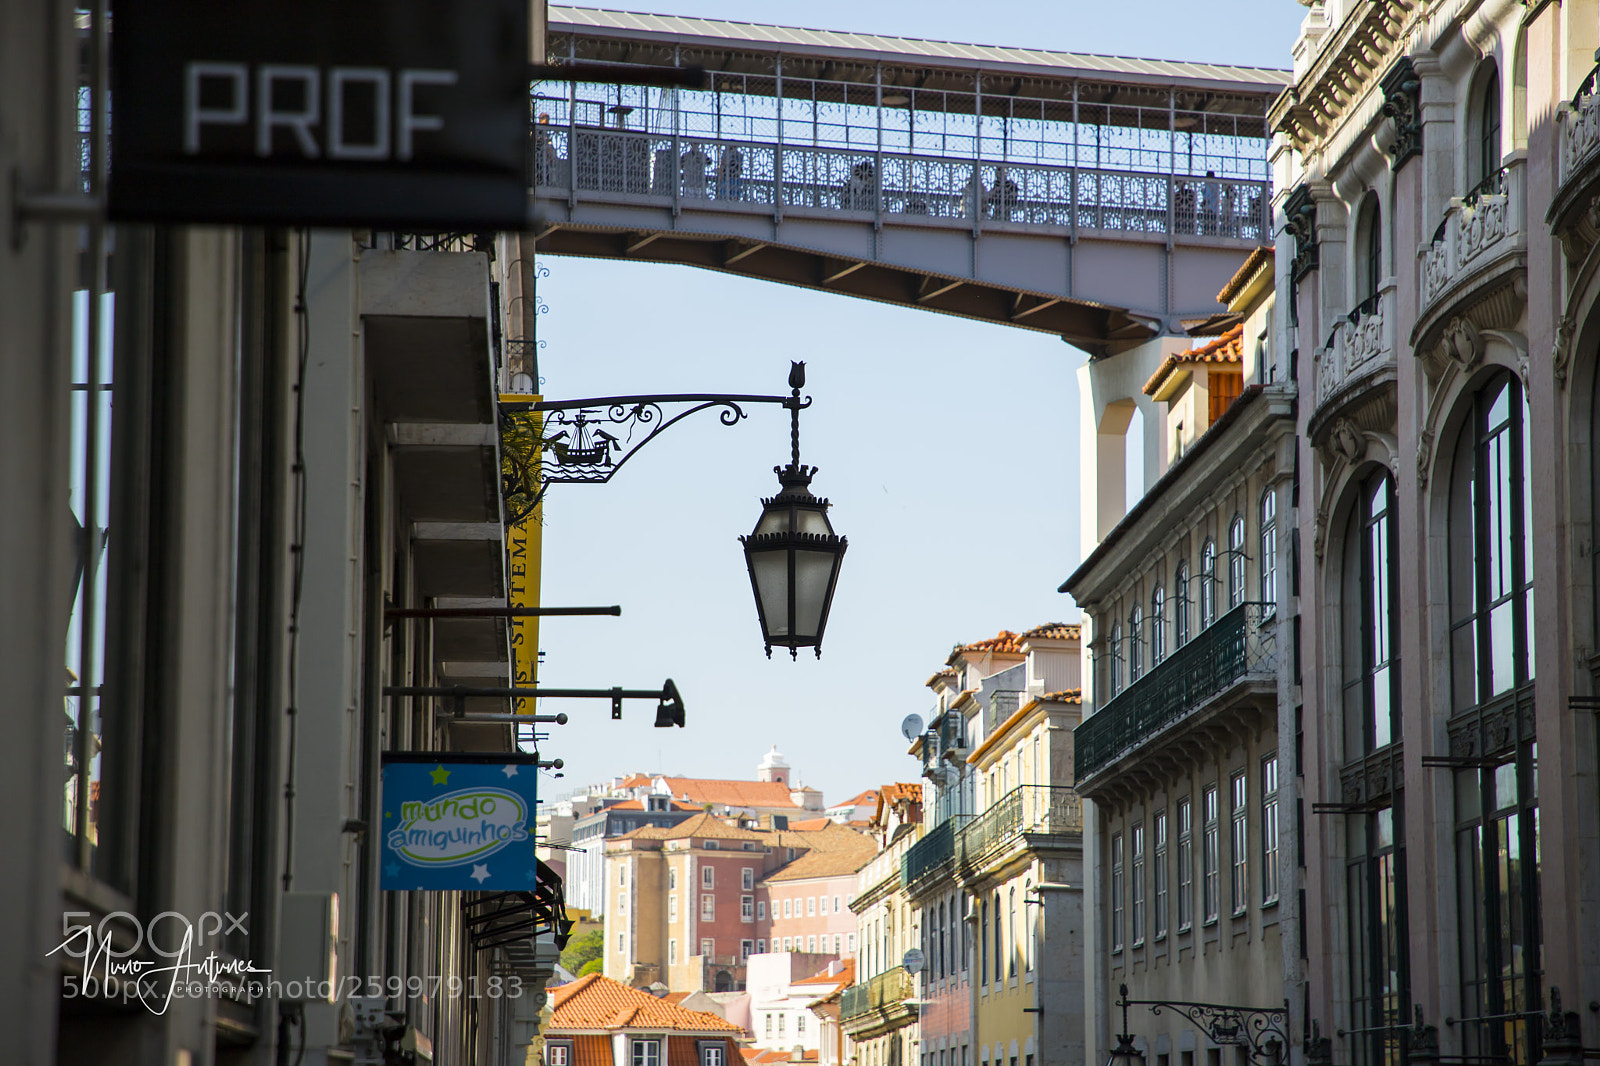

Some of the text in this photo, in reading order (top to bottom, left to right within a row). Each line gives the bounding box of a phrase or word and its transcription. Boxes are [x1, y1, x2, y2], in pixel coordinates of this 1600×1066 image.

[183, 61, 459, 162] PROF
[402, 797, 496, 823] mundo
[389, 819, 527, 851] amiguinhos
